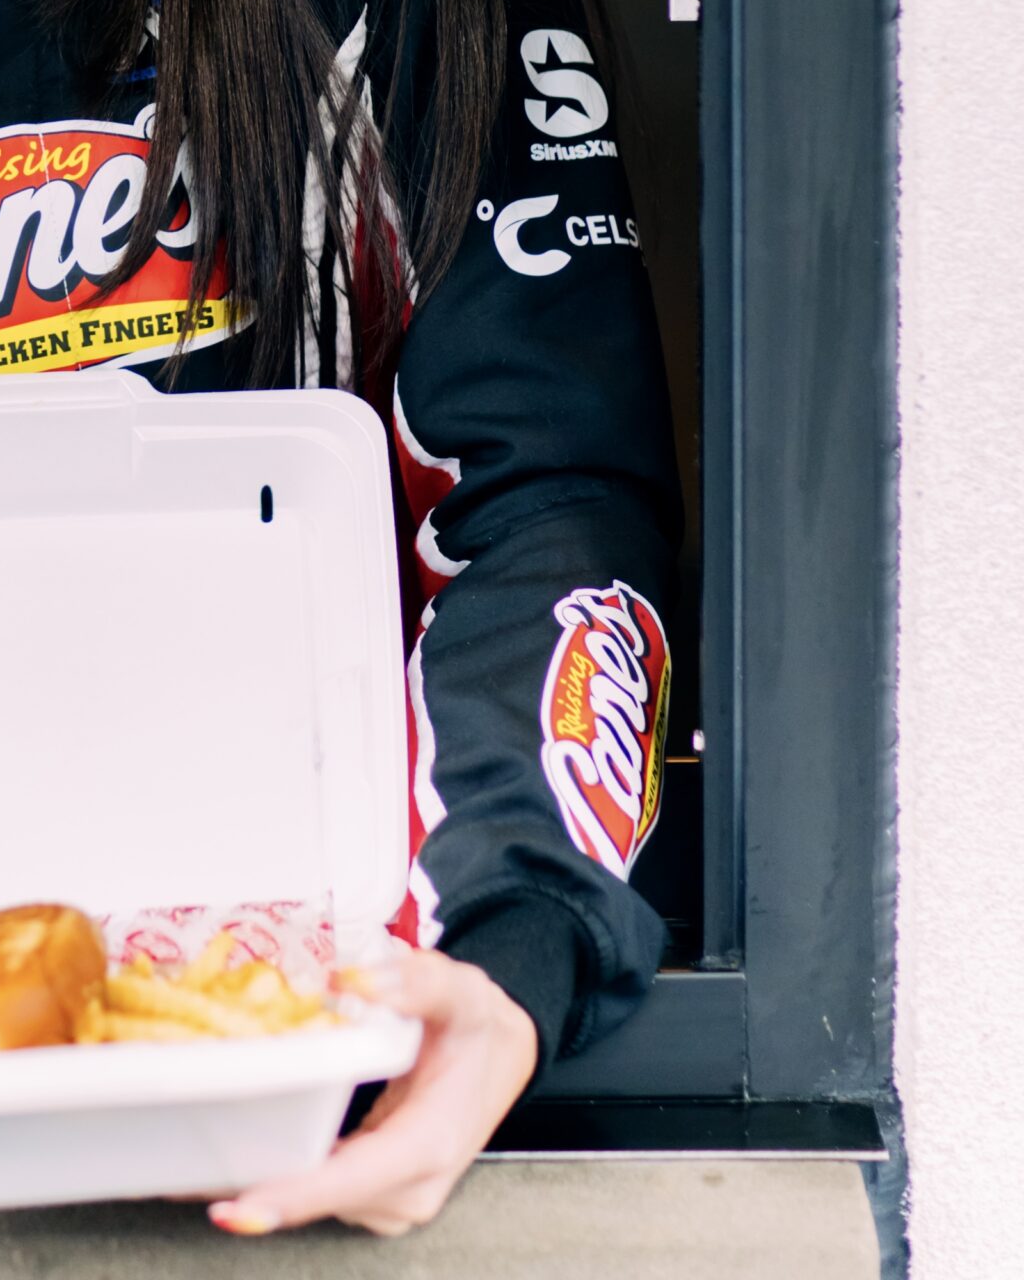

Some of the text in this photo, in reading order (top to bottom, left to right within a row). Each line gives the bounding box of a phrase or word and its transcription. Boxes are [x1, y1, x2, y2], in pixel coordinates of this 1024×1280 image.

[530, 140, 618, 161] SiriusXM
[565, 214, 641, 248] CELS
[557, 651, 596, 744] Raising
